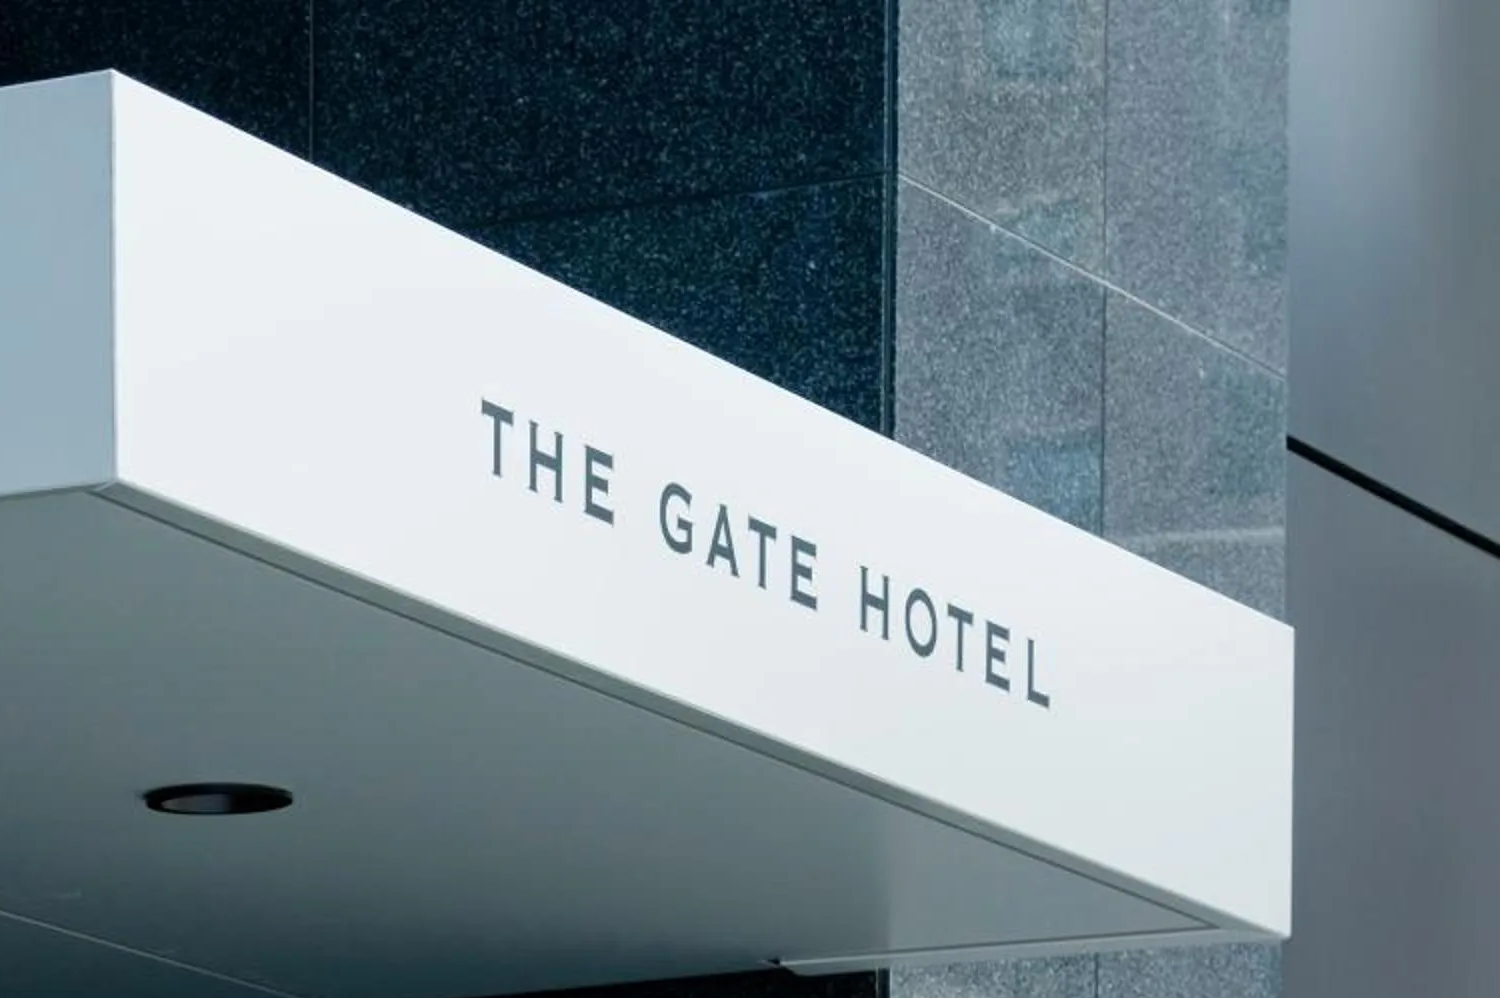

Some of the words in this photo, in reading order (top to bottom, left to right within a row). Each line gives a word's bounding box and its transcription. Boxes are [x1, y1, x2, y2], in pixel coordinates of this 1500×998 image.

[481, 397, 614, 527] THE
[659, 482, 818, 612] GATE
[859, 565, 1050, 709] HOTEL
